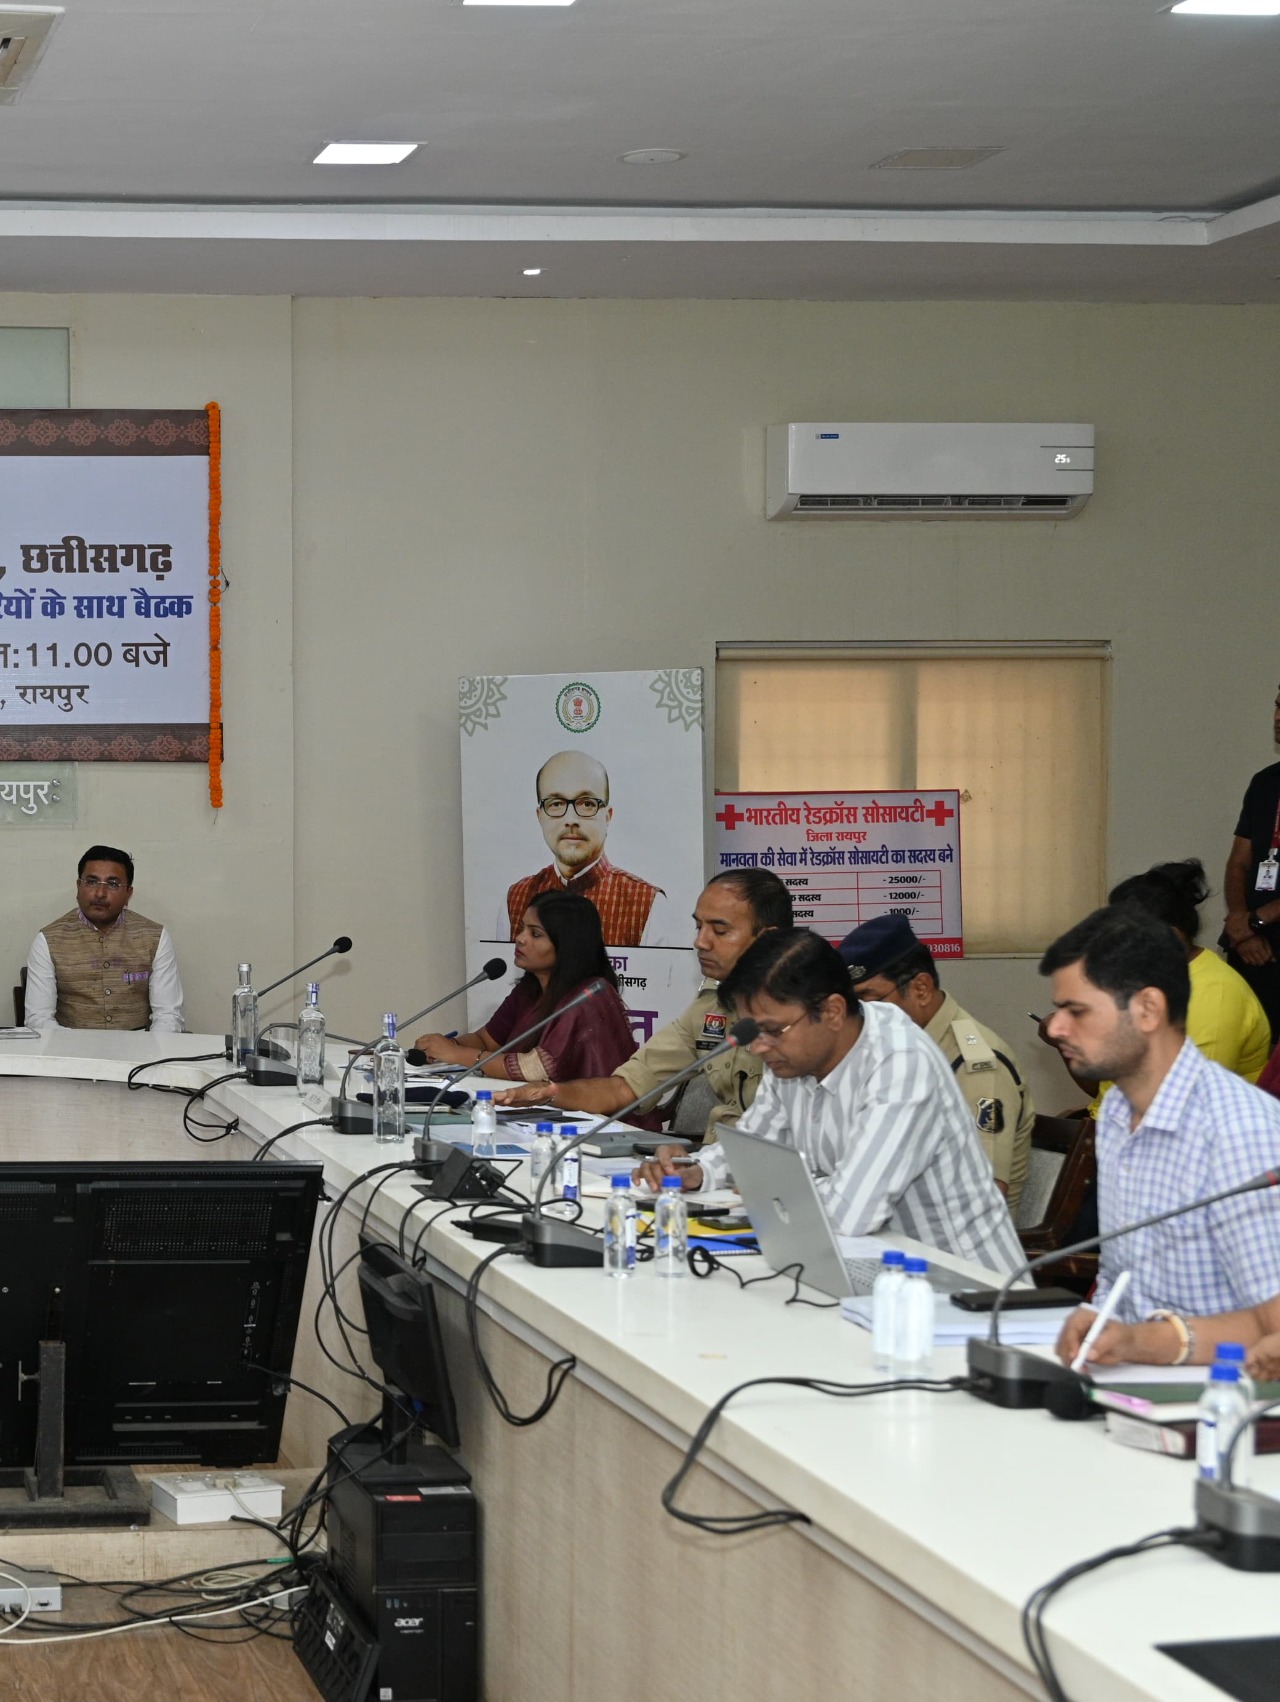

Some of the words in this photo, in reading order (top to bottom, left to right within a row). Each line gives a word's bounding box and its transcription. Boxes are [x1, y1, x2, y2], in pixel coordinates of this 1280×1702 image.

[20, 535, 172, 580] छत्तीसगढ़
[40, 588, 66, 619] के
[73, 595, 127, 619] साथ
[130, 587, 194, 619] बैठक
[122, 633, 170, 669] बजे
[15, 685, 90, 712] रायपुर
[746, 801, 801, 826] भारतीय
[804, 801, 858, 826] रेडक्रॉस
[862, 798, 926, 825] सोसायटी
[806, 829, 833, 842] जिला
[836, 831, 867, 843] रायपुर
[720, 852, 757, 868] मानवता
[761, 847, 775, 867] की
[777, 847, 797, 867] सेवा
[799, 847, 808, 866] में
[809, 846, 845, 866] रेडक्रॉस
[848, 844, 889, 865] सोसायटी
[891, 848, 906, 865] का
[907, 848, 936, 864] सदस्य
[938, 843, 954, 863] बने
[785, 878, 808, 887] सदस्य
[798, 894, 821, 902] सदस्य
[394, 1617, 424, 1627] acer
